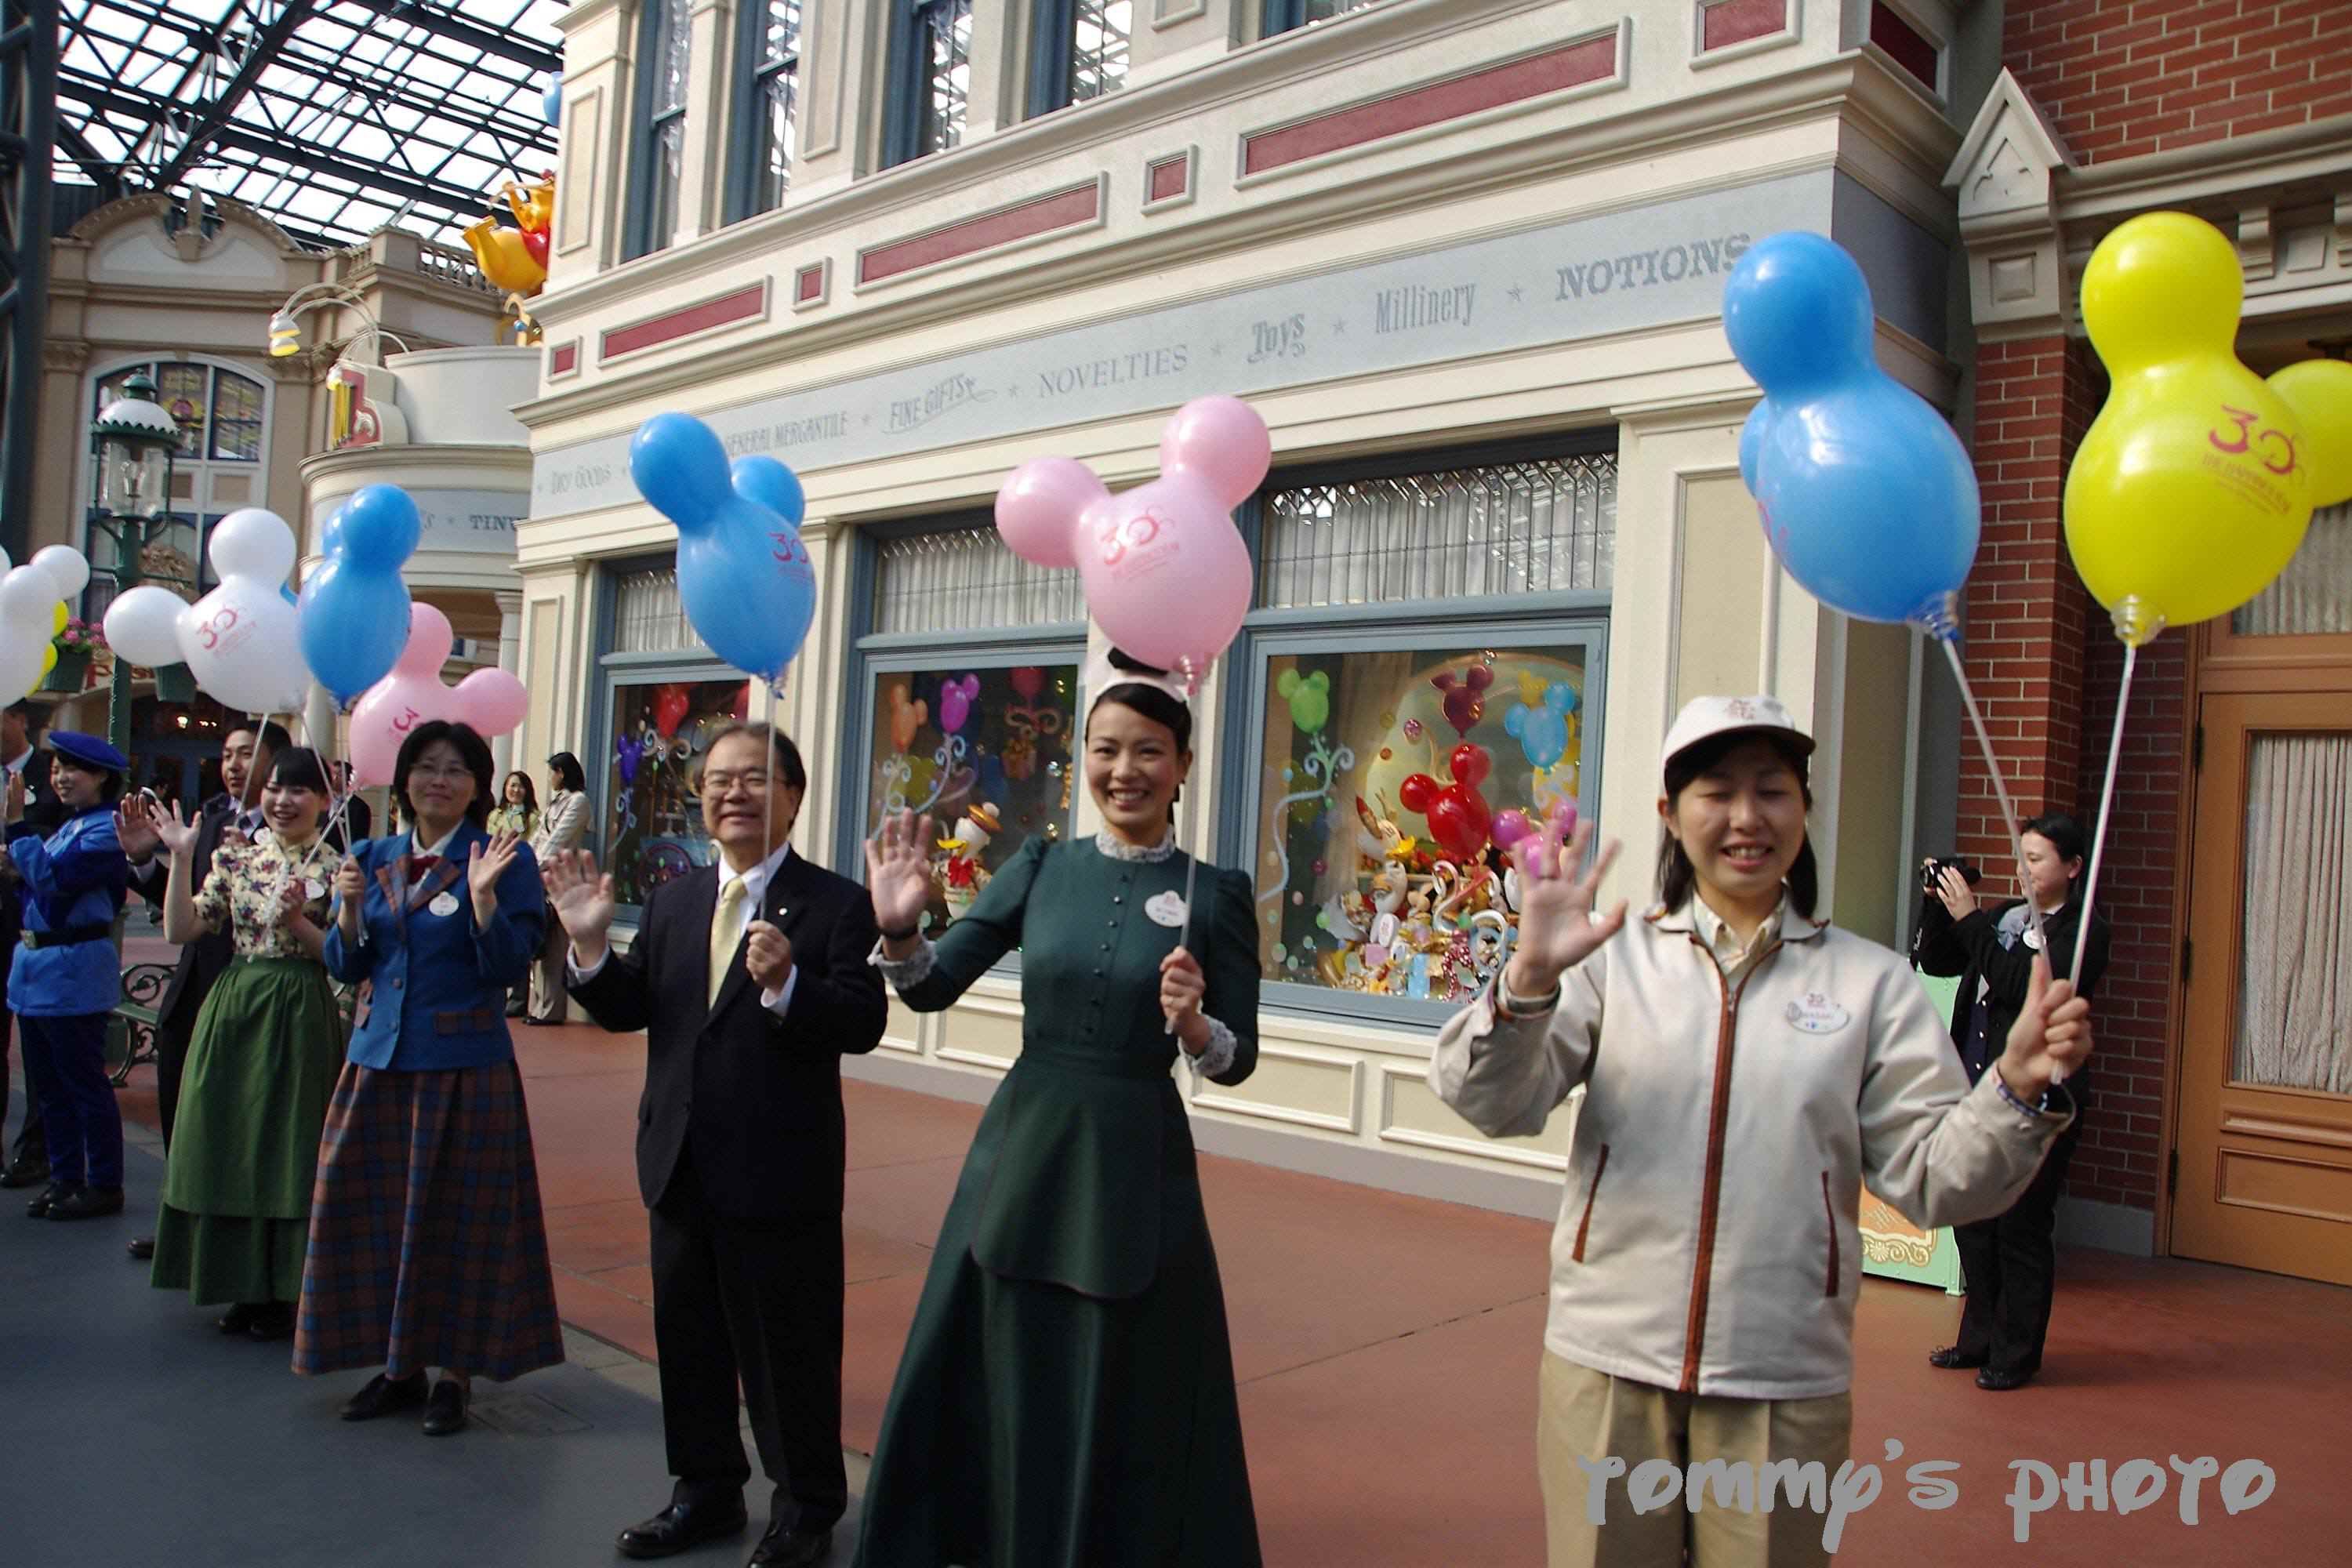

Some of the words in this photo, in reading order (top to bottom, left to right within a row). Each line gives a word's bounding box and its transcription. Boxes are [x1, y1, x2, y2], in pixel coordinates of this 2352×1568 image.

[774, 411, 848, 448] MERCANTILE
[889, 397, 920, 429] FINE
[924, 372, 966, 414] GIFTS
[1039, 343, 1188, 398] NOVELTIES
[1247, 313, 1306, 364] Toys
[1374, 283, 1477, 334] Millinery
[1555, 233, 1751, 302] NOTIONS
[393, 706, 423, 732] 3
